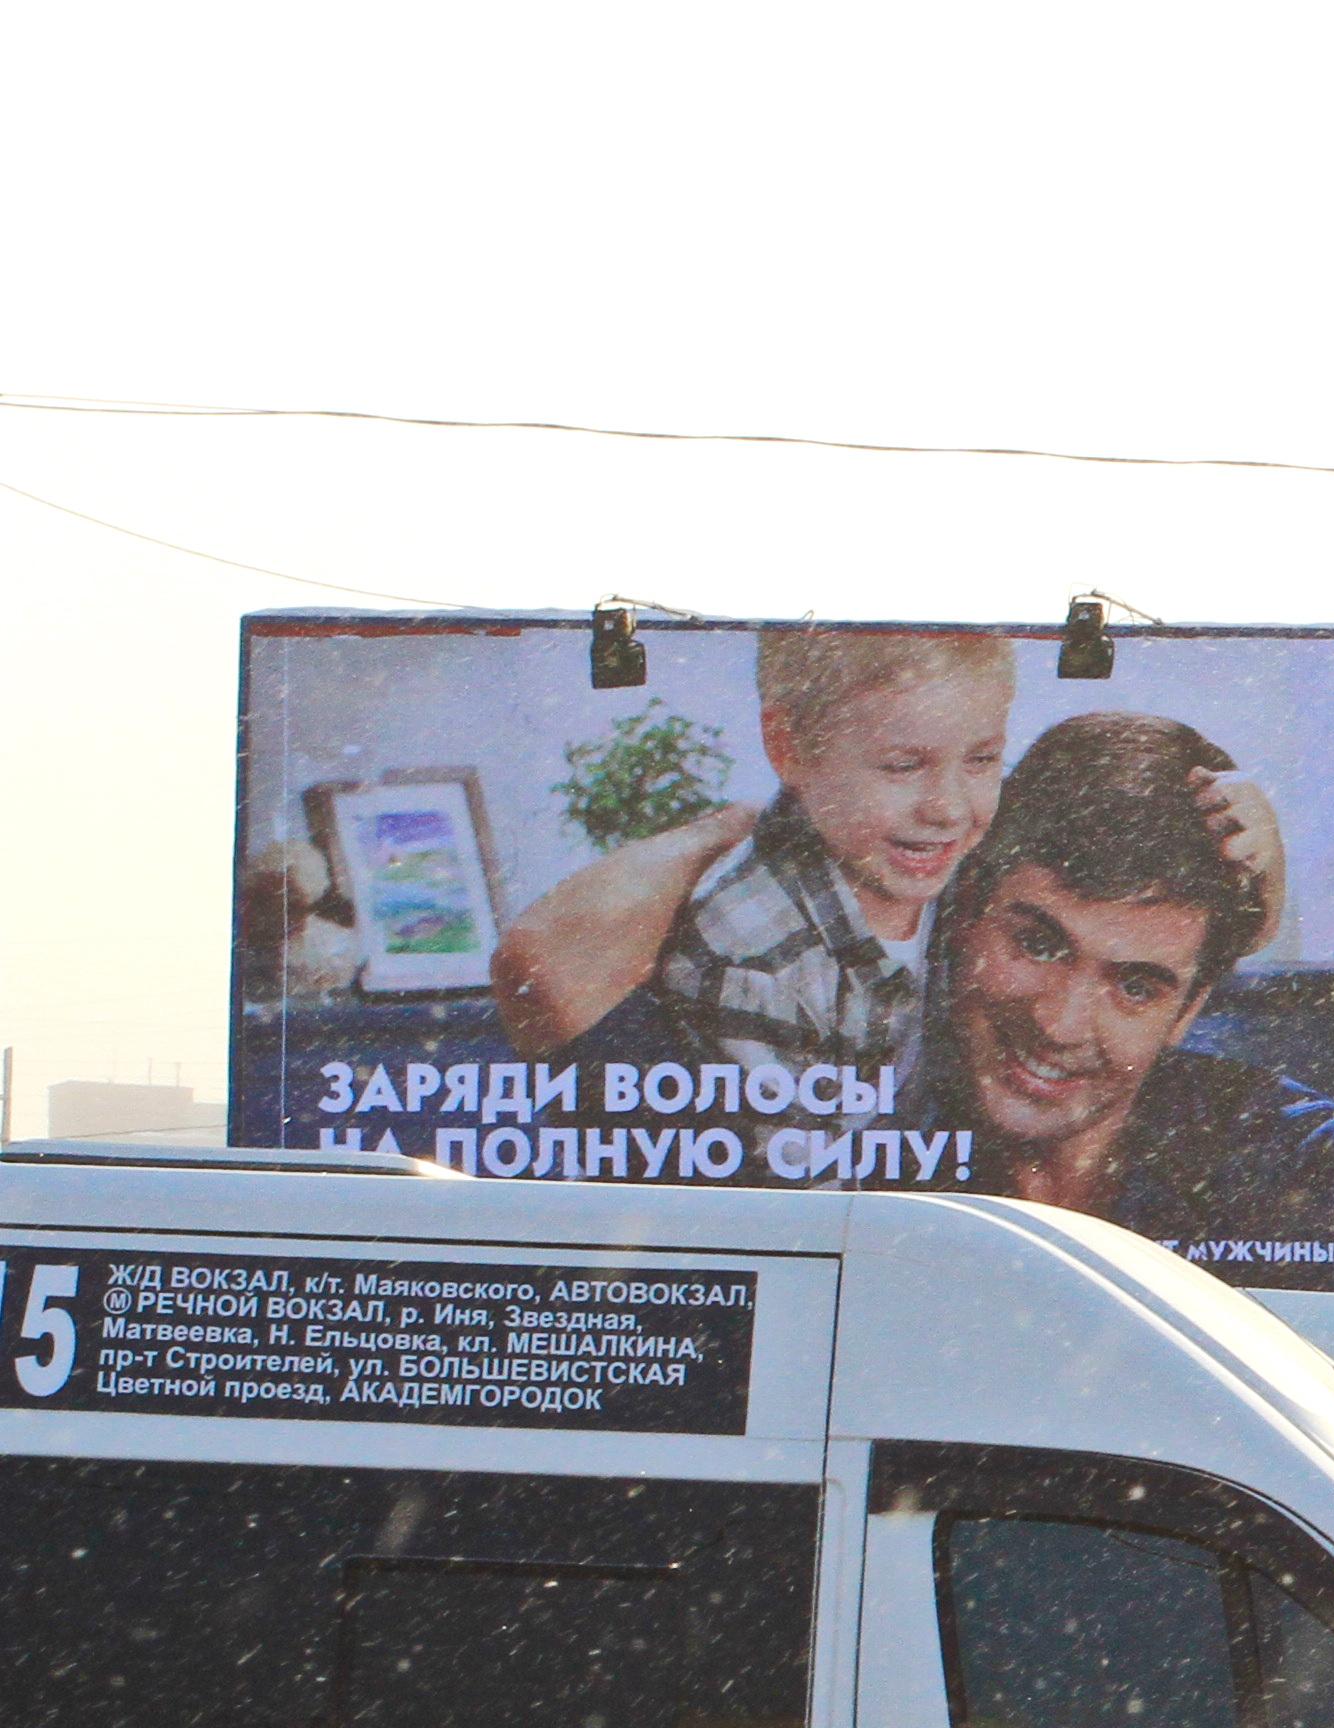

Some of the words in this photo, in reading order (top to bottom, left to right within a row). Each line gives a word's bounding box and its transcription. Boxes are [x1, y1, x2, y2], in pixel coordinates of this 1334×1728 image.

[318, 1061, 577, 1125] ЗАРЯДИ
[605, 1062, 895, 1117] ВОЛОСЫ
[435, 1127, 743, 1181] ПОЛНУЮ
[767, 1128, 973, 1183] СИЛУ!
[1187, 1241, 1334, 1263] МУЖЧИНЫ
[108, 1264, 162, 1290] Ж/Д
[171, 1266, 295, 1295] ВОКЗАЛ,
[305, 1272, 344, 1295] к/т.
[355, 1274, 541, 1303] Маяковского,
[550, 1281, 754, 1309] АВТОВОКЗАЛ,
[0, 1259, 79, 1397] 5
[137, 1291, 258, 1318] РЕЧНОЙ
[267, 1299, 391, 1326] ВОКЗАЛ,
[400, 1308, 425, 1328] р.
[434, 1304, 495, 1329] Иня,
[504, 1305, 643, 1334] Звездная,
[102, 1317, 259, 1346] Матвеевка,
[269, 1324, 296, 1346] Н.
[305, 1325, 449, 1354] Ельцовка,
[457, 1335, 497, 1353] кл.
[507, 1332, 704, 1363] МЕШАЛКИНА,
[99, 1348, 157, 1371] пр-т
[165, 1346, 339, 1378] Строителей,
[350, 1360, 390, 1379] ул.
[399, 1355, 686, 1386] БОЛЬШЕВИСТСКАЯ
[96, 1371, 216, 1398] Цветной
[224, 1380, 331, 1404] проезд,
[340, 1381, 603, 1413] АКАДЕМГОРОДОК
